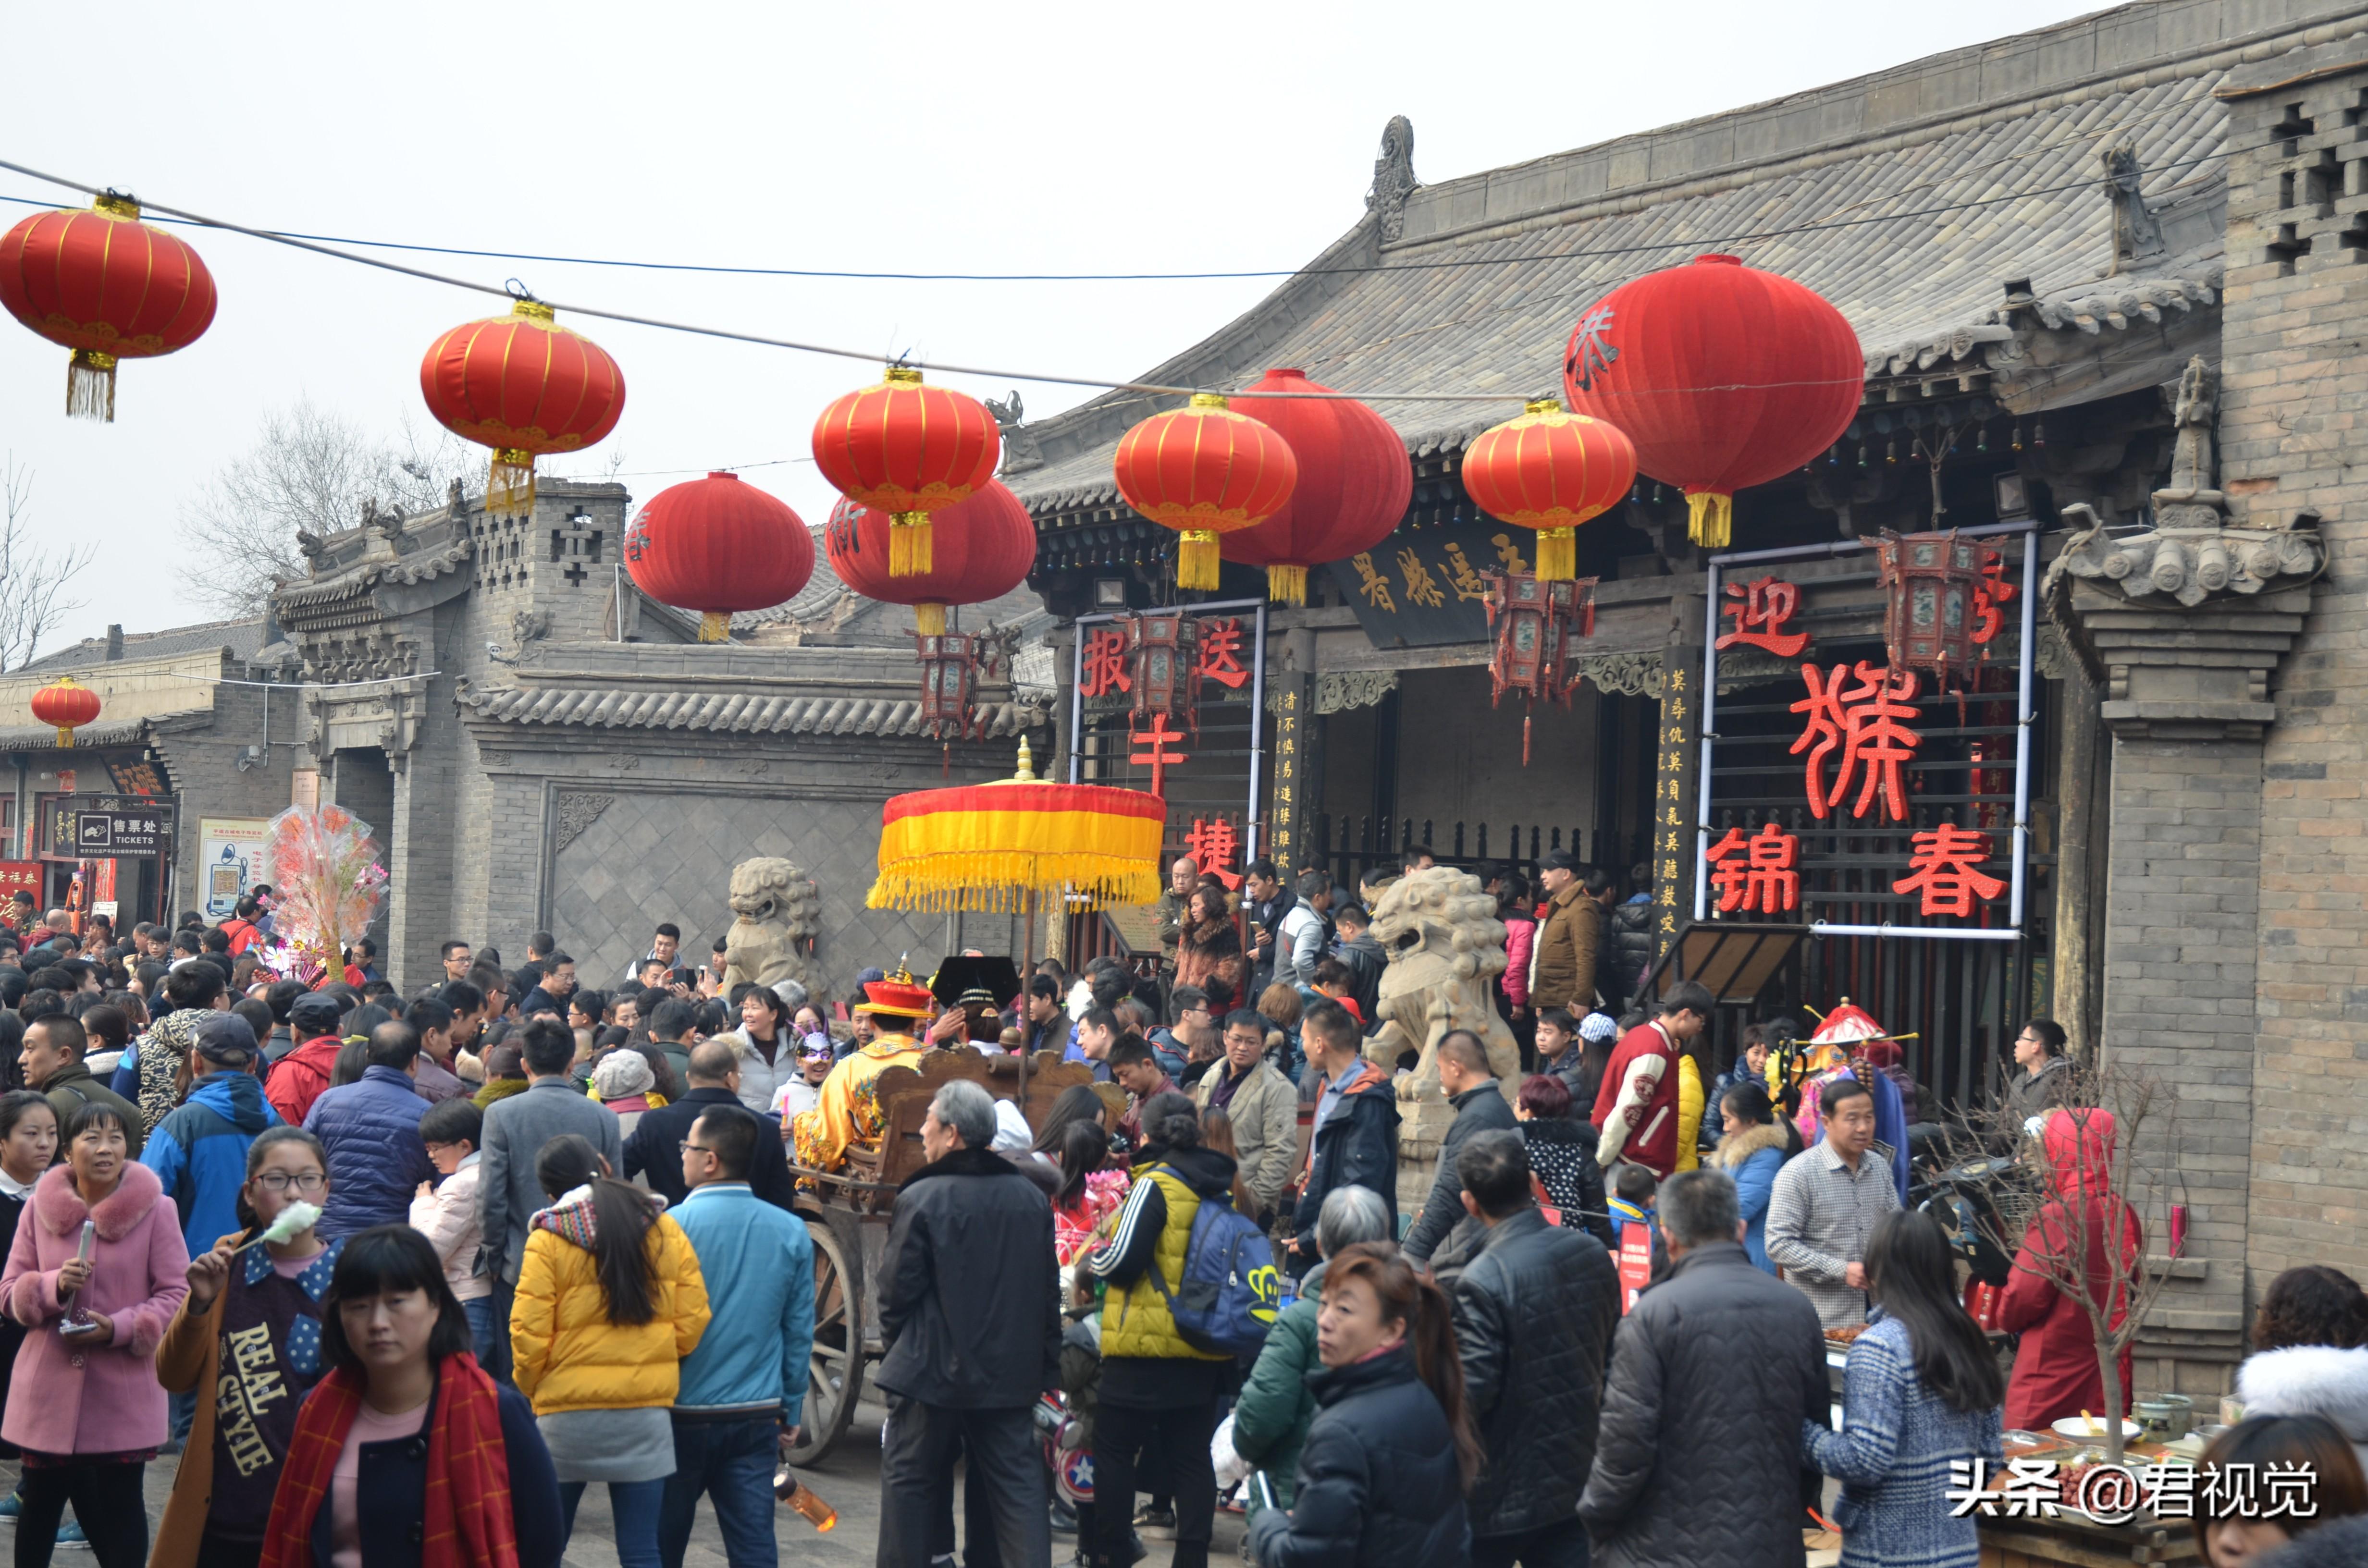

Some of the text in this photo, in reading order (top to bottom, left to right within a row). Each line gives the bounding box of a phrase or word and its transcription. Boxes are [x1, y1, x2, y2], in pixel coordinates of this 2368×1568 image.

[627, 511, 651, 562] 春
[828, 496, 867, 556] 新
[1715, 576, 1812, 657] 迎
[1079, 629, 1132, 696] 报
[1196, 617, 1252, 688] 送
[113, 820, 157, 833] 售票处
[115, 836, 154, 845] TICKETS
[1184, 818, 1244, 891] 捷
[1704, 823, 1799, 913] 锦
[1893, 823, 2009, 918] 春
[229, 1322, 288, 1415] REAL
